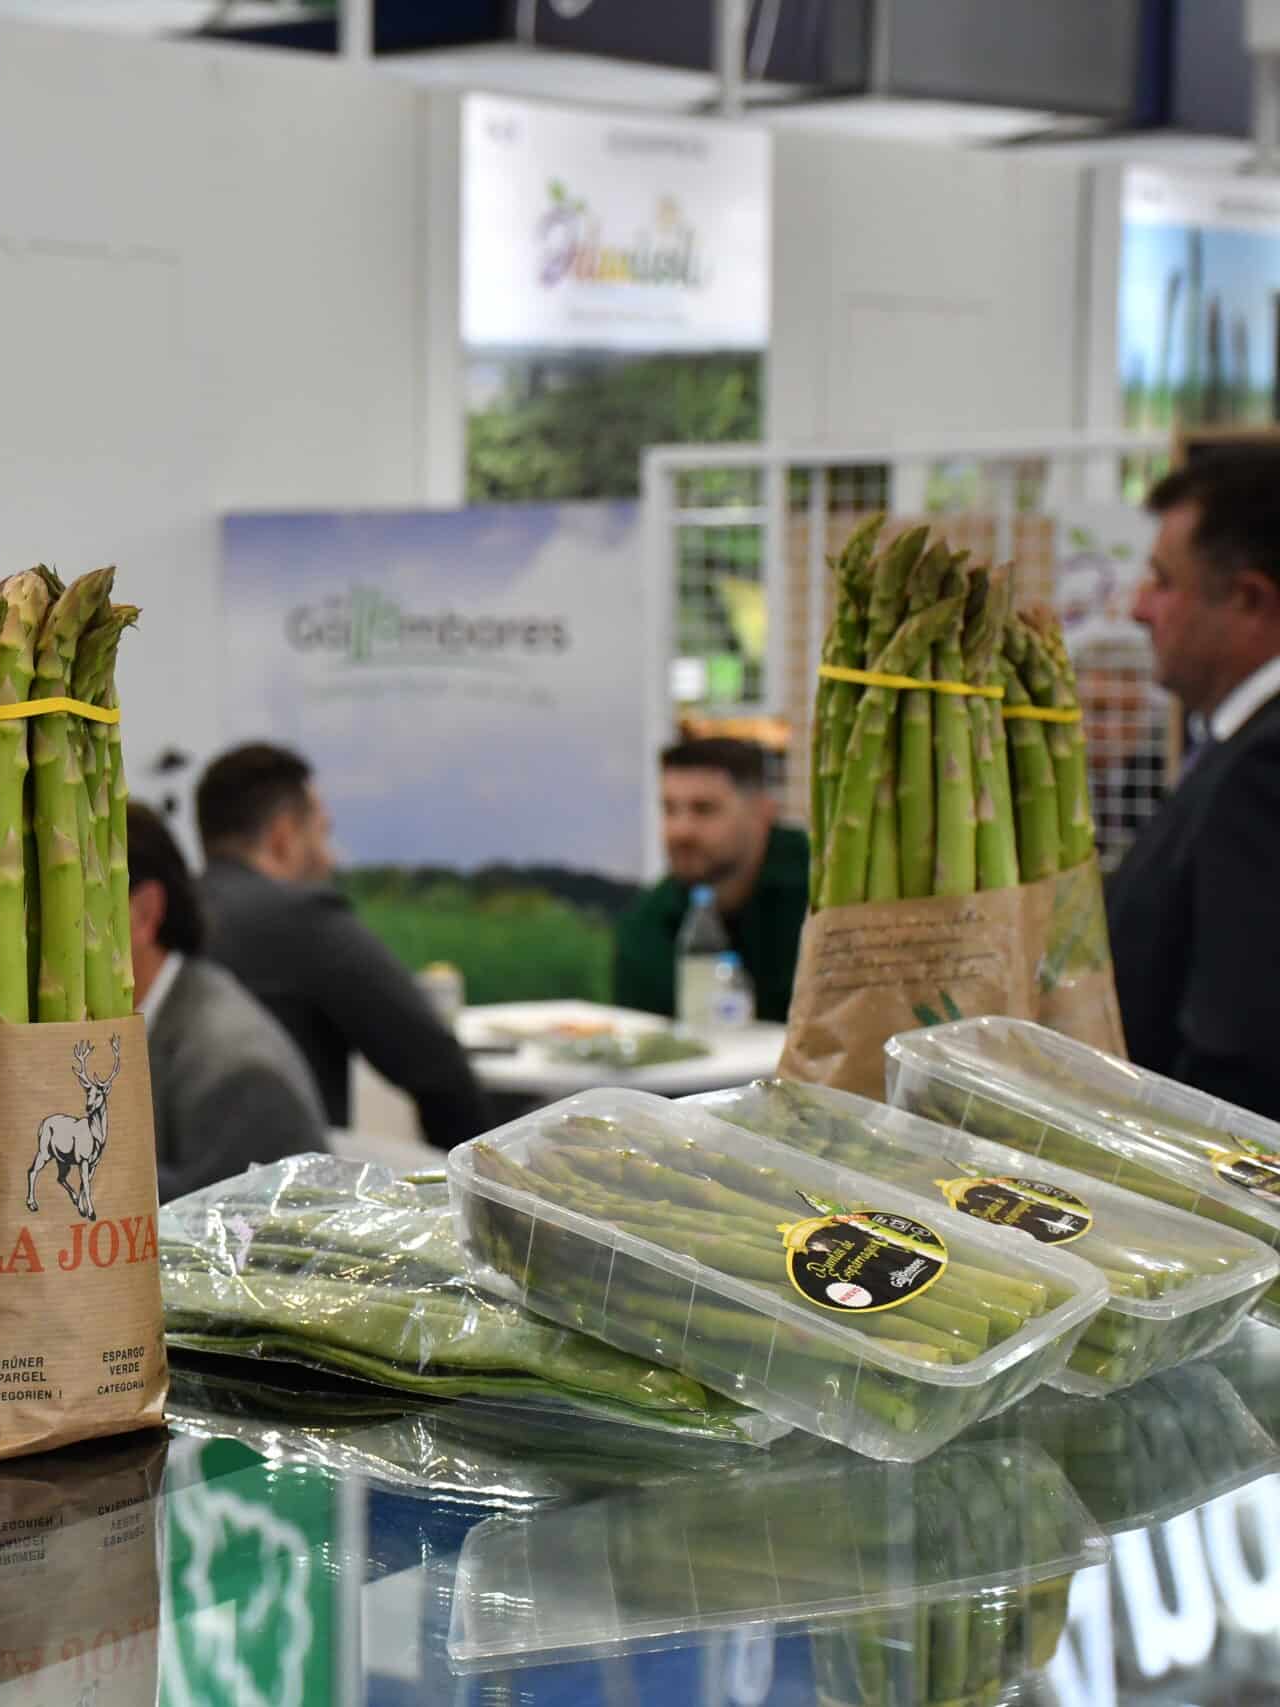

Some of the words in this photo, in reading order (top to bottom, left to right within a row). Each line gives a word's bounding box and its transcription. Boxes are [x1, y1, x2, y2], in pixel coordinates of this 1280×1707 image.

[58, 1215, 158, 1272] JOYA
[102, 1346, 144, 1363] ESPARGO
[109, 1361, 140, 1376] VERDE
